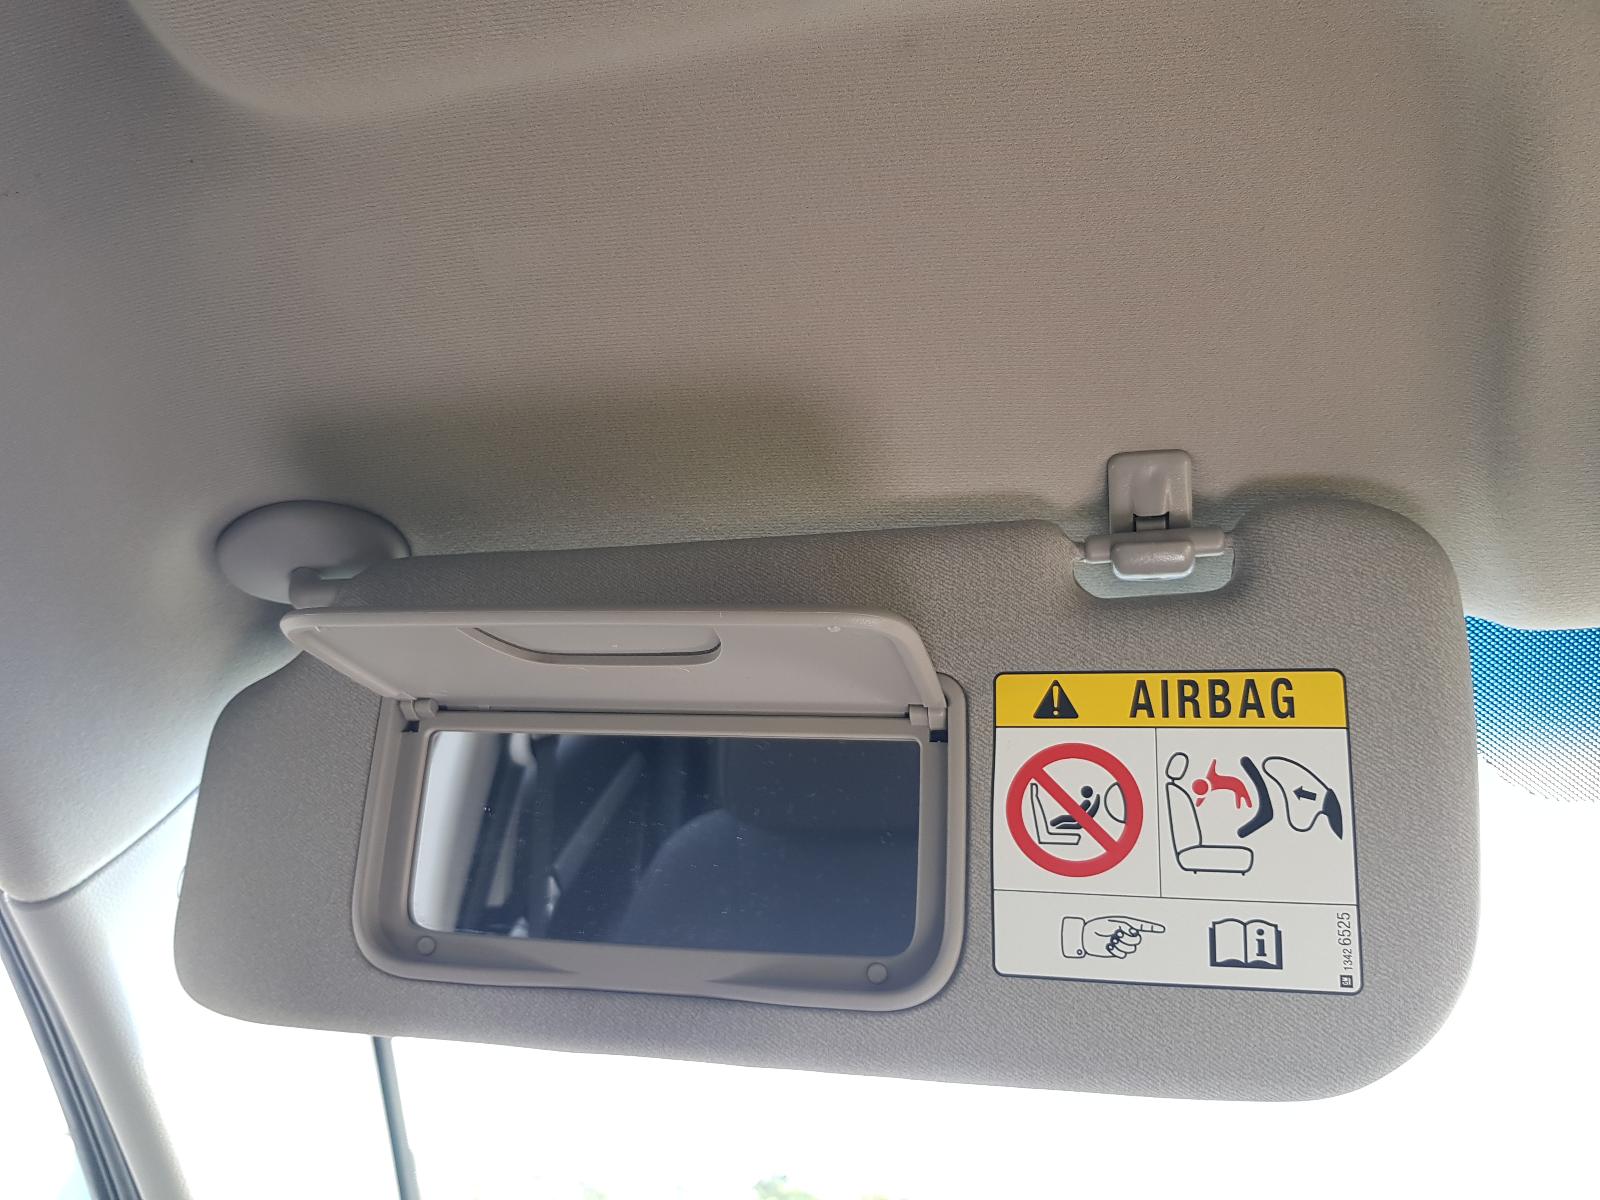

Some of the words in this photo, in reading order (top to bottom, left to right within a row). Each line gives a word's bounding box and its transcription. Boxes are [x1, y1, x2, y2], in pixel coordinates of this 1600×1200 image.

[1129, 677, 1296, 719] AIRBAG
[1336, 912, 1351, 946] 6525
[1342, 948, 1353, 971] 1342
